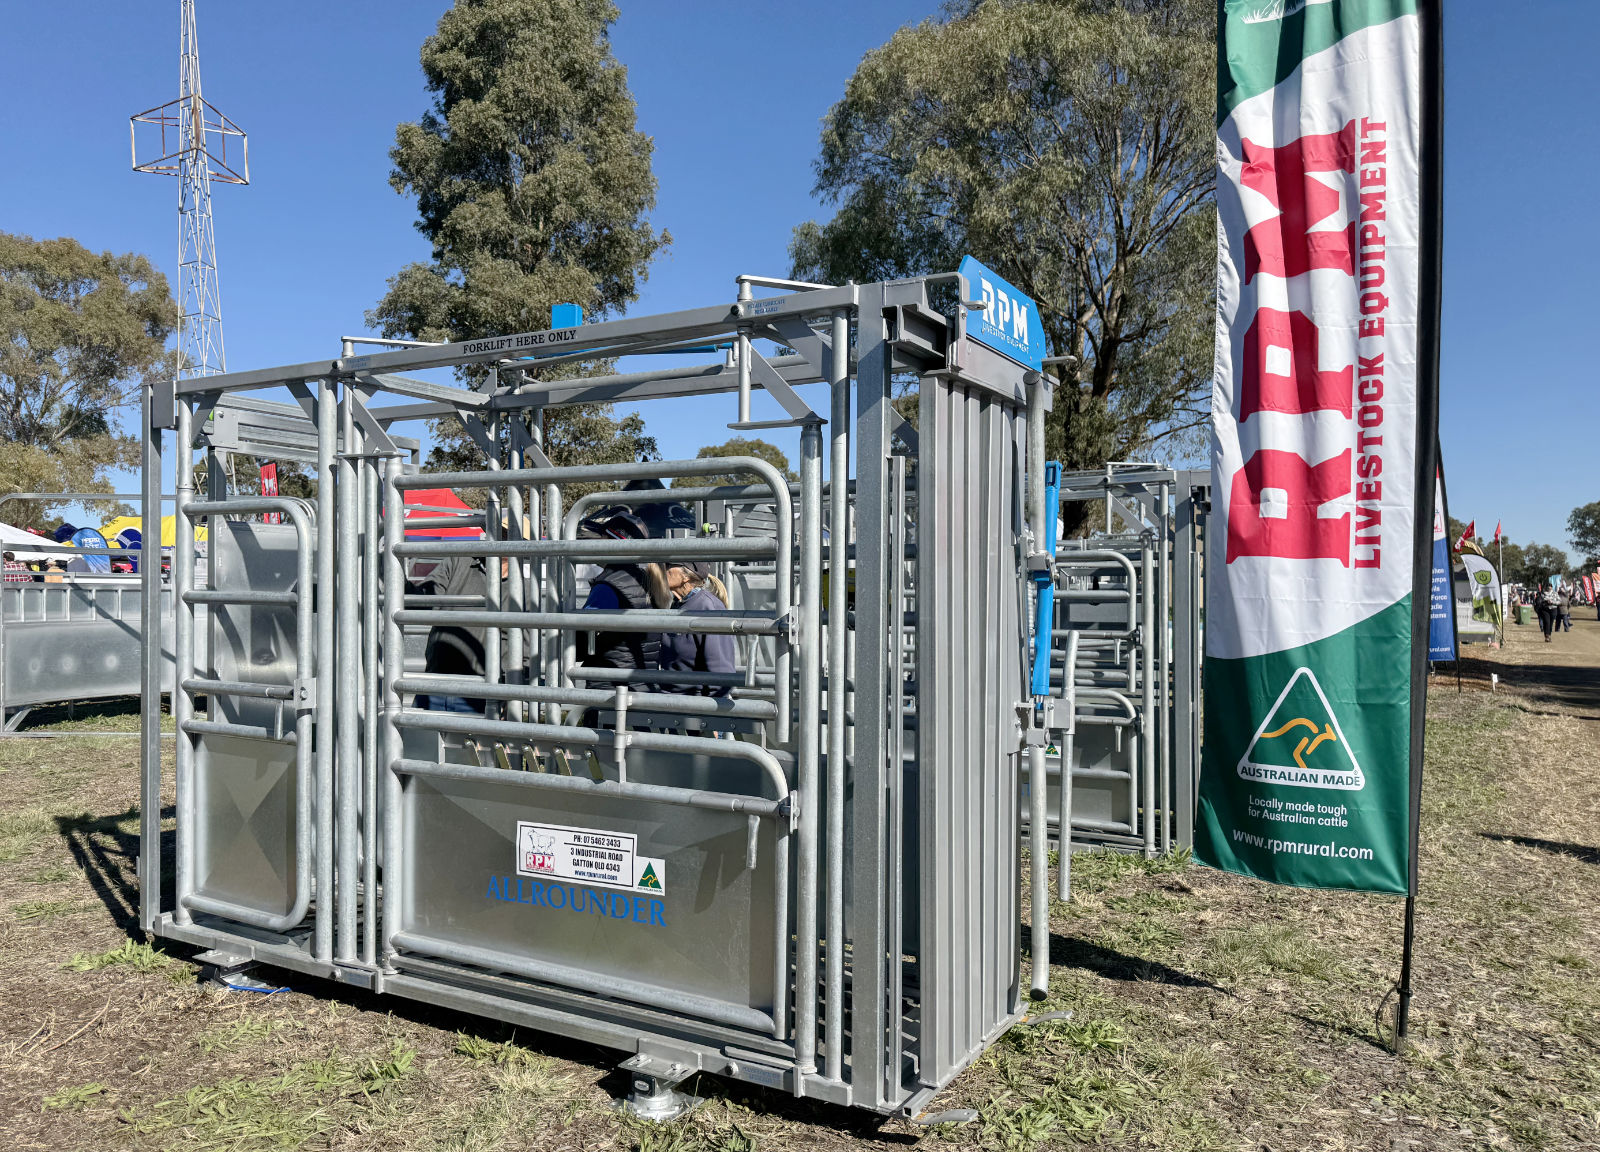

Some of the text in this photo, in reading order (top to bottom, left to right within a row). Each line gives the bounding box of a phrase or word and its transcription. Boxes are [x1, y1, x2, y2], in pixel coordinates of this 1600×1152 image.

[981, 277, 1029, 346] RPM
[463, 329, 577, 354] FORKLIFT HERE ONLY
[1225, 118, 1357, 569] RPM
[1354, 116, 1387, 569] LIVESTOCK EQUIPMENT
[1240, 765, 1361, 787] AUSTRALIAN MADE
[1249, 795, 1347, 815] Locally made tough
[1248, 806, 1348, 827] for Australian cattle
[583, 836, 591, 844] 07
[591, 837, 606, 846] 5462
[606, 838, 621, 848] 3433
[1232, 829, 1374, 860] www.rpmrural.com
[526, 855, 555, 869] RPM
[570, 847, 623, 862] 3 INDUSTRIAL ROAD
[572, 858, 621, 872] GATTON QLD 4343
[485, 875, 667, 927] ALLROUNDER
